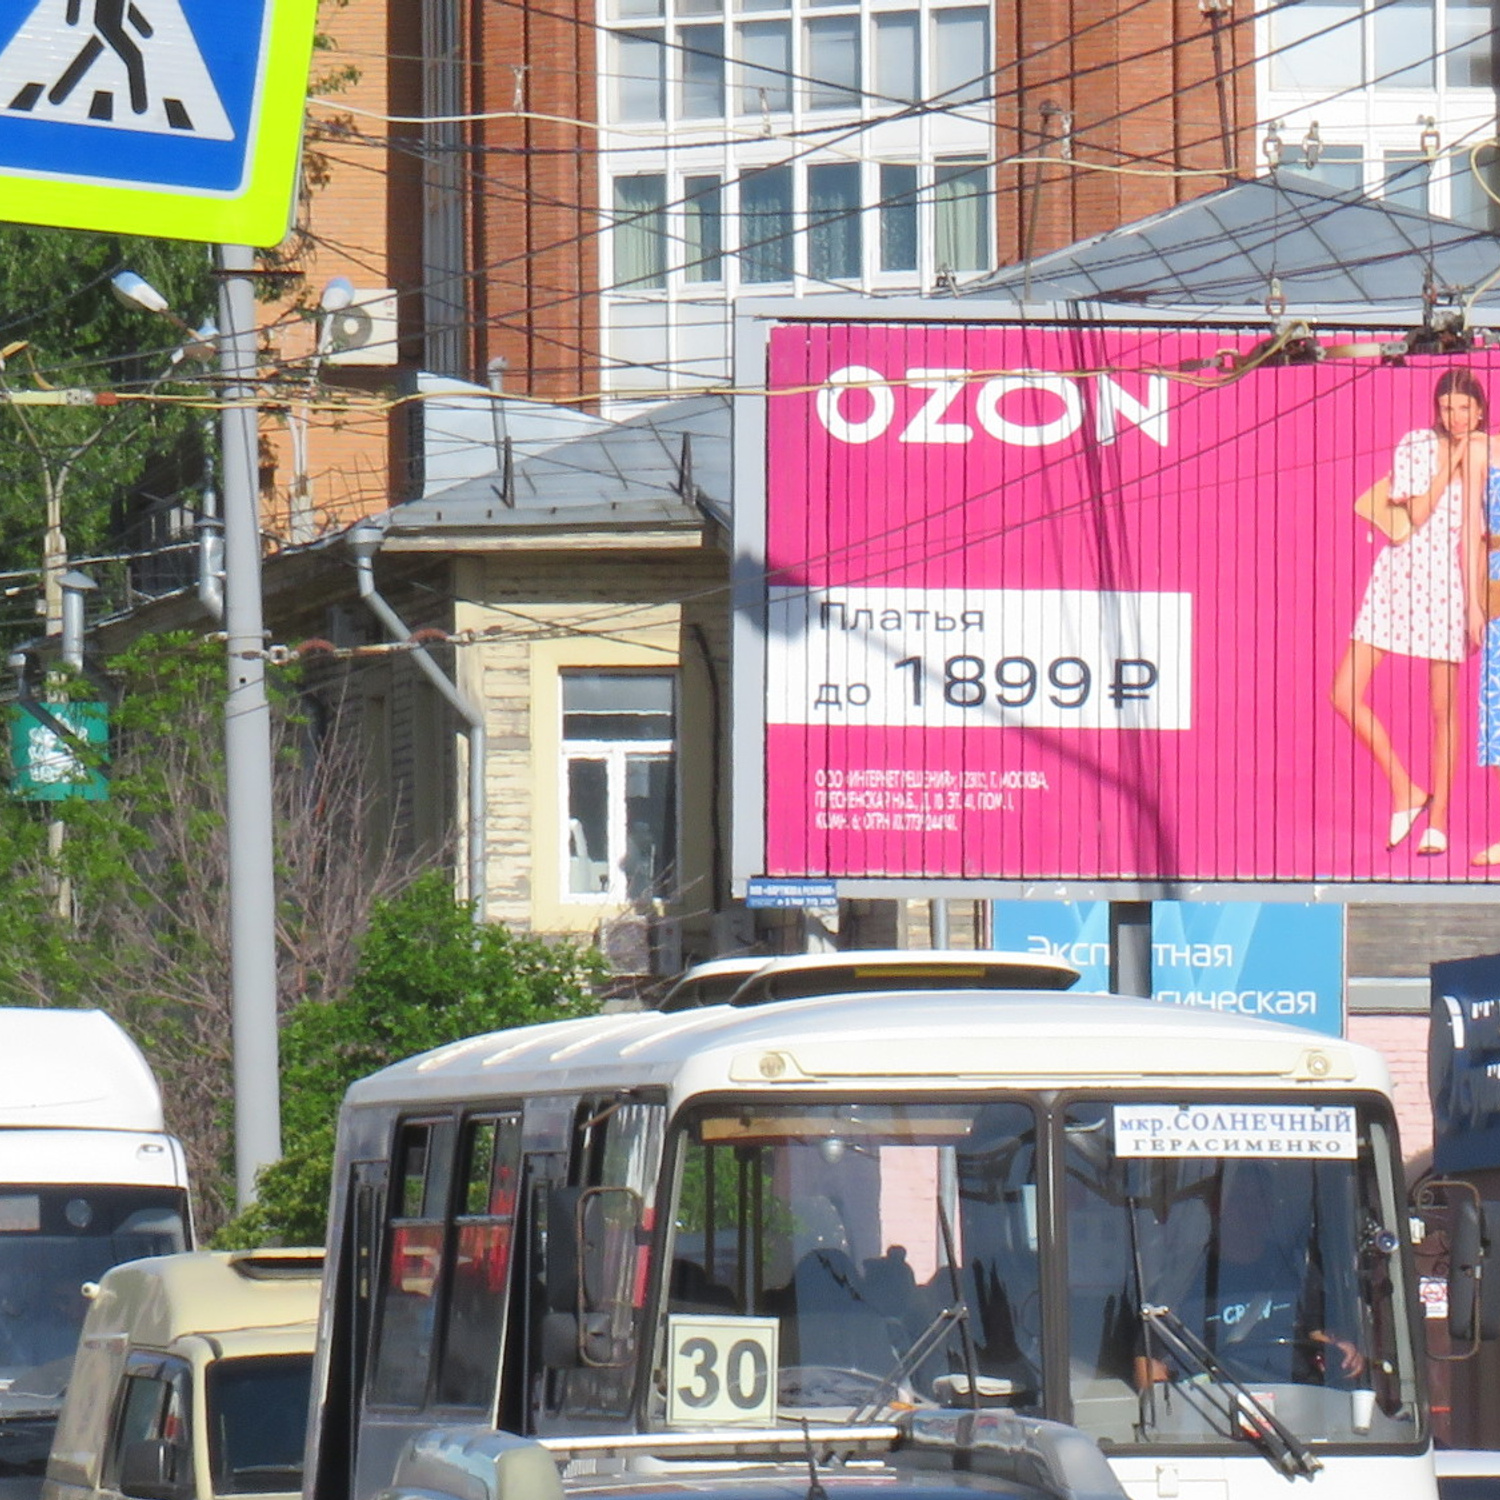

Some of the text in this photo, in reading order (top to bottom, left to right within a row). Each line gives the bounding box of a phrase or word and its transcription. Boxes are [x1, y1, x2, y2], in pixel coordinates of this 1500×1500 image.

[816, 365, 1169, 447] OZON
[819, 602, 985, 633] Платья
[1134, 1138, 1342, 1153] ГЕРАСИМЕНКО
[677, 1336, 768, 1411] 30
